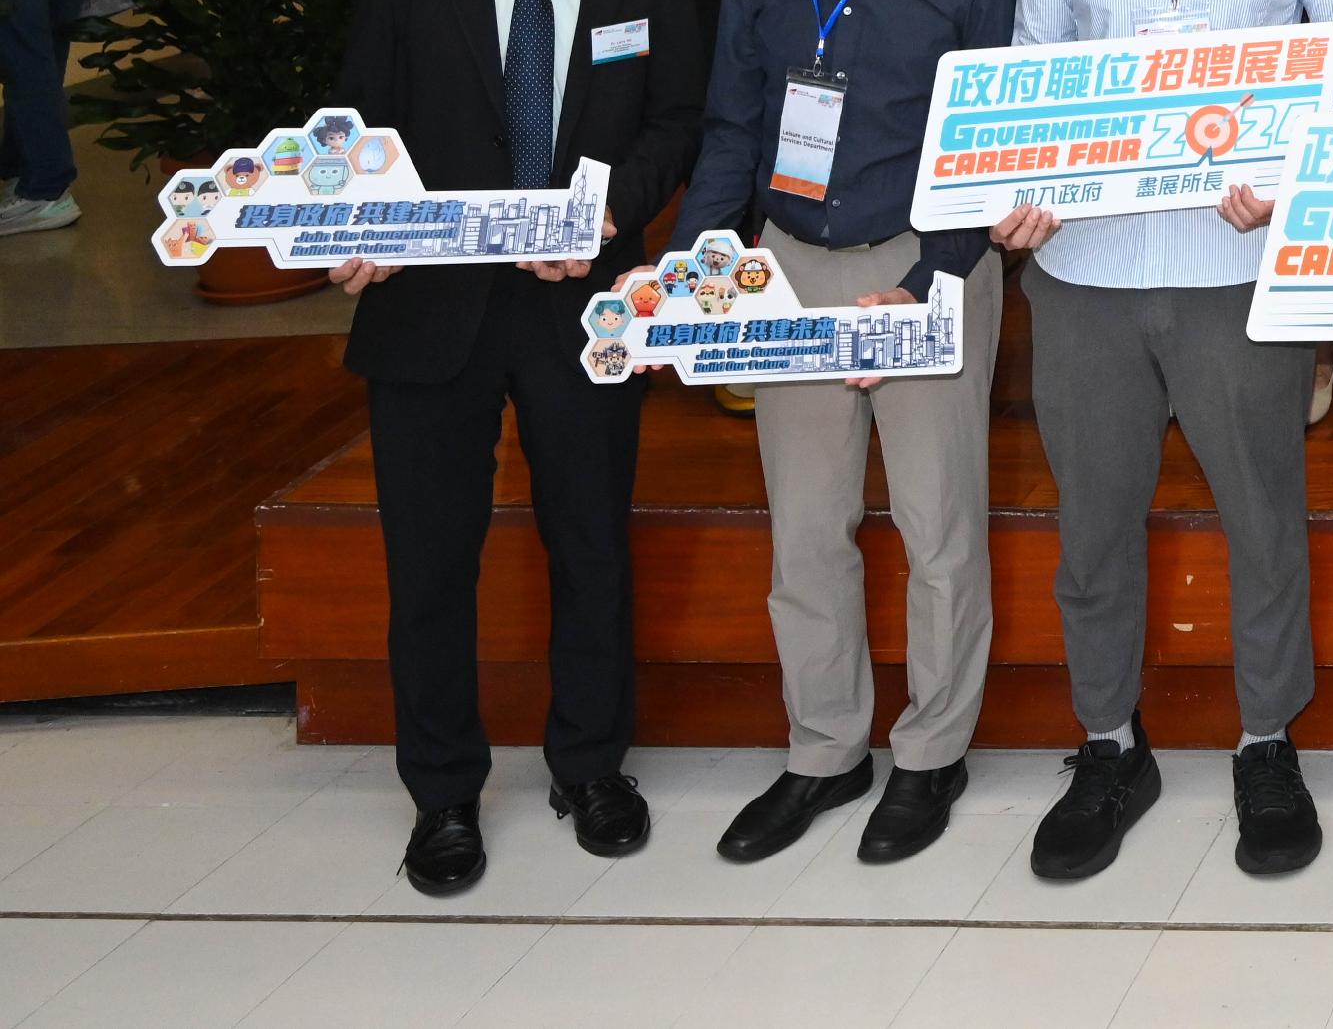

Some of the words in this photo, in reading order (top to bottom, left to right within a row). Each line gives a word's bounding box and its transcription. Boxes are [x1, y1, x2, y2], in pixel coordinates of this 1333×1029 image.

[947, 36, 1330, 108] 政府職位招聘展覽
[934, 145, 1058, 178] CAREER
[1066, 138, 1142, 168] FAIR
[1012, 182, 1103, 210] 加入政府
[1135, 171, 1225, 199] 盡展所長
[235, 203, 354, 229] 投身政府
[348, 200, 467, 226] 共建未來
[290, 243, 328, 256] Build
[329, 243, 356, 256] Our
[356, 242, 407, 254] Future
[294, 231, 331, 244] Join
[331, 229, 360, 242] the
[360, 226, 458, 241] Government
[646, 320, 741, 346] 投身政府
[742, 316, 837, 342] 共建未來
[695, 347, 725, 360] Join
[726, 346, 750, 358] the
[751, 343, 834, 358] Government
[748, 359, 790, 371] Future
